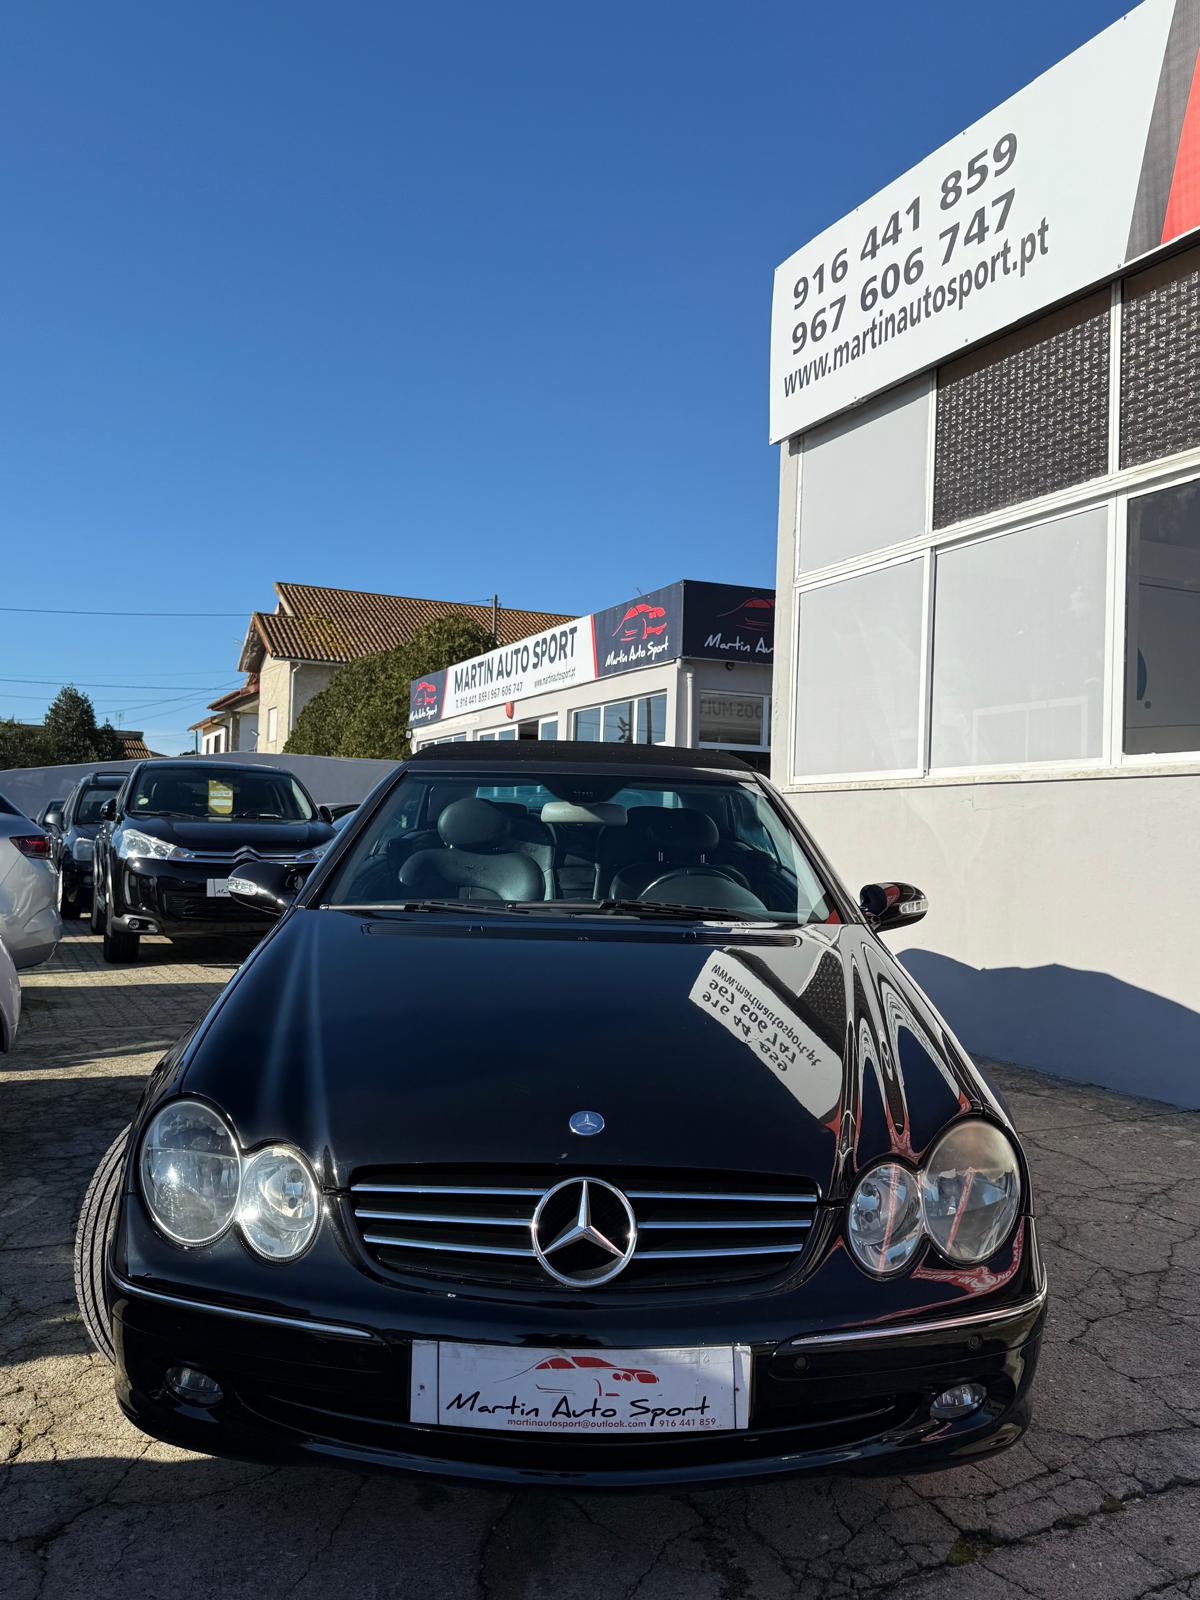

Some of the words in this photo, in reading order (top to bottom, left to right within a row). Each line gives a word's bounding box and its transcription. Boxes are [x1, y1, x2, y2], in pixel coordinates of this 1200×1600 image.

[793, 247, 848, 310] 916
[860, 195, 921, 262] 441
[939, 132, 1018, 211] 859
[791, 294, 847, 355] 967
[859, 246, 924, 312] 606
[938, 187, 1016, 266] 747
[783, 216, 1049, 398] www.martinautosport.pt
[454, 656, 494, 695] MARTIN
[496, 645, 530, 680] AUTO
[532, 626, 578, 669] SPORT
[604, 649, 628, 667] Martin
[629, 644, 646, 661] Auto
[647, 635, 669, 661] Sport
[705, 632, 751, 652] Martin
[446, 1390, 540, 1418] Martin
[551, 1395, 617, 1418] Auto
[629, 1395, 710, 1427] Sport
[507, 1418, 647, 1429] martinautosport@outlook.com
[699, 1418, 716, 1426] 859
